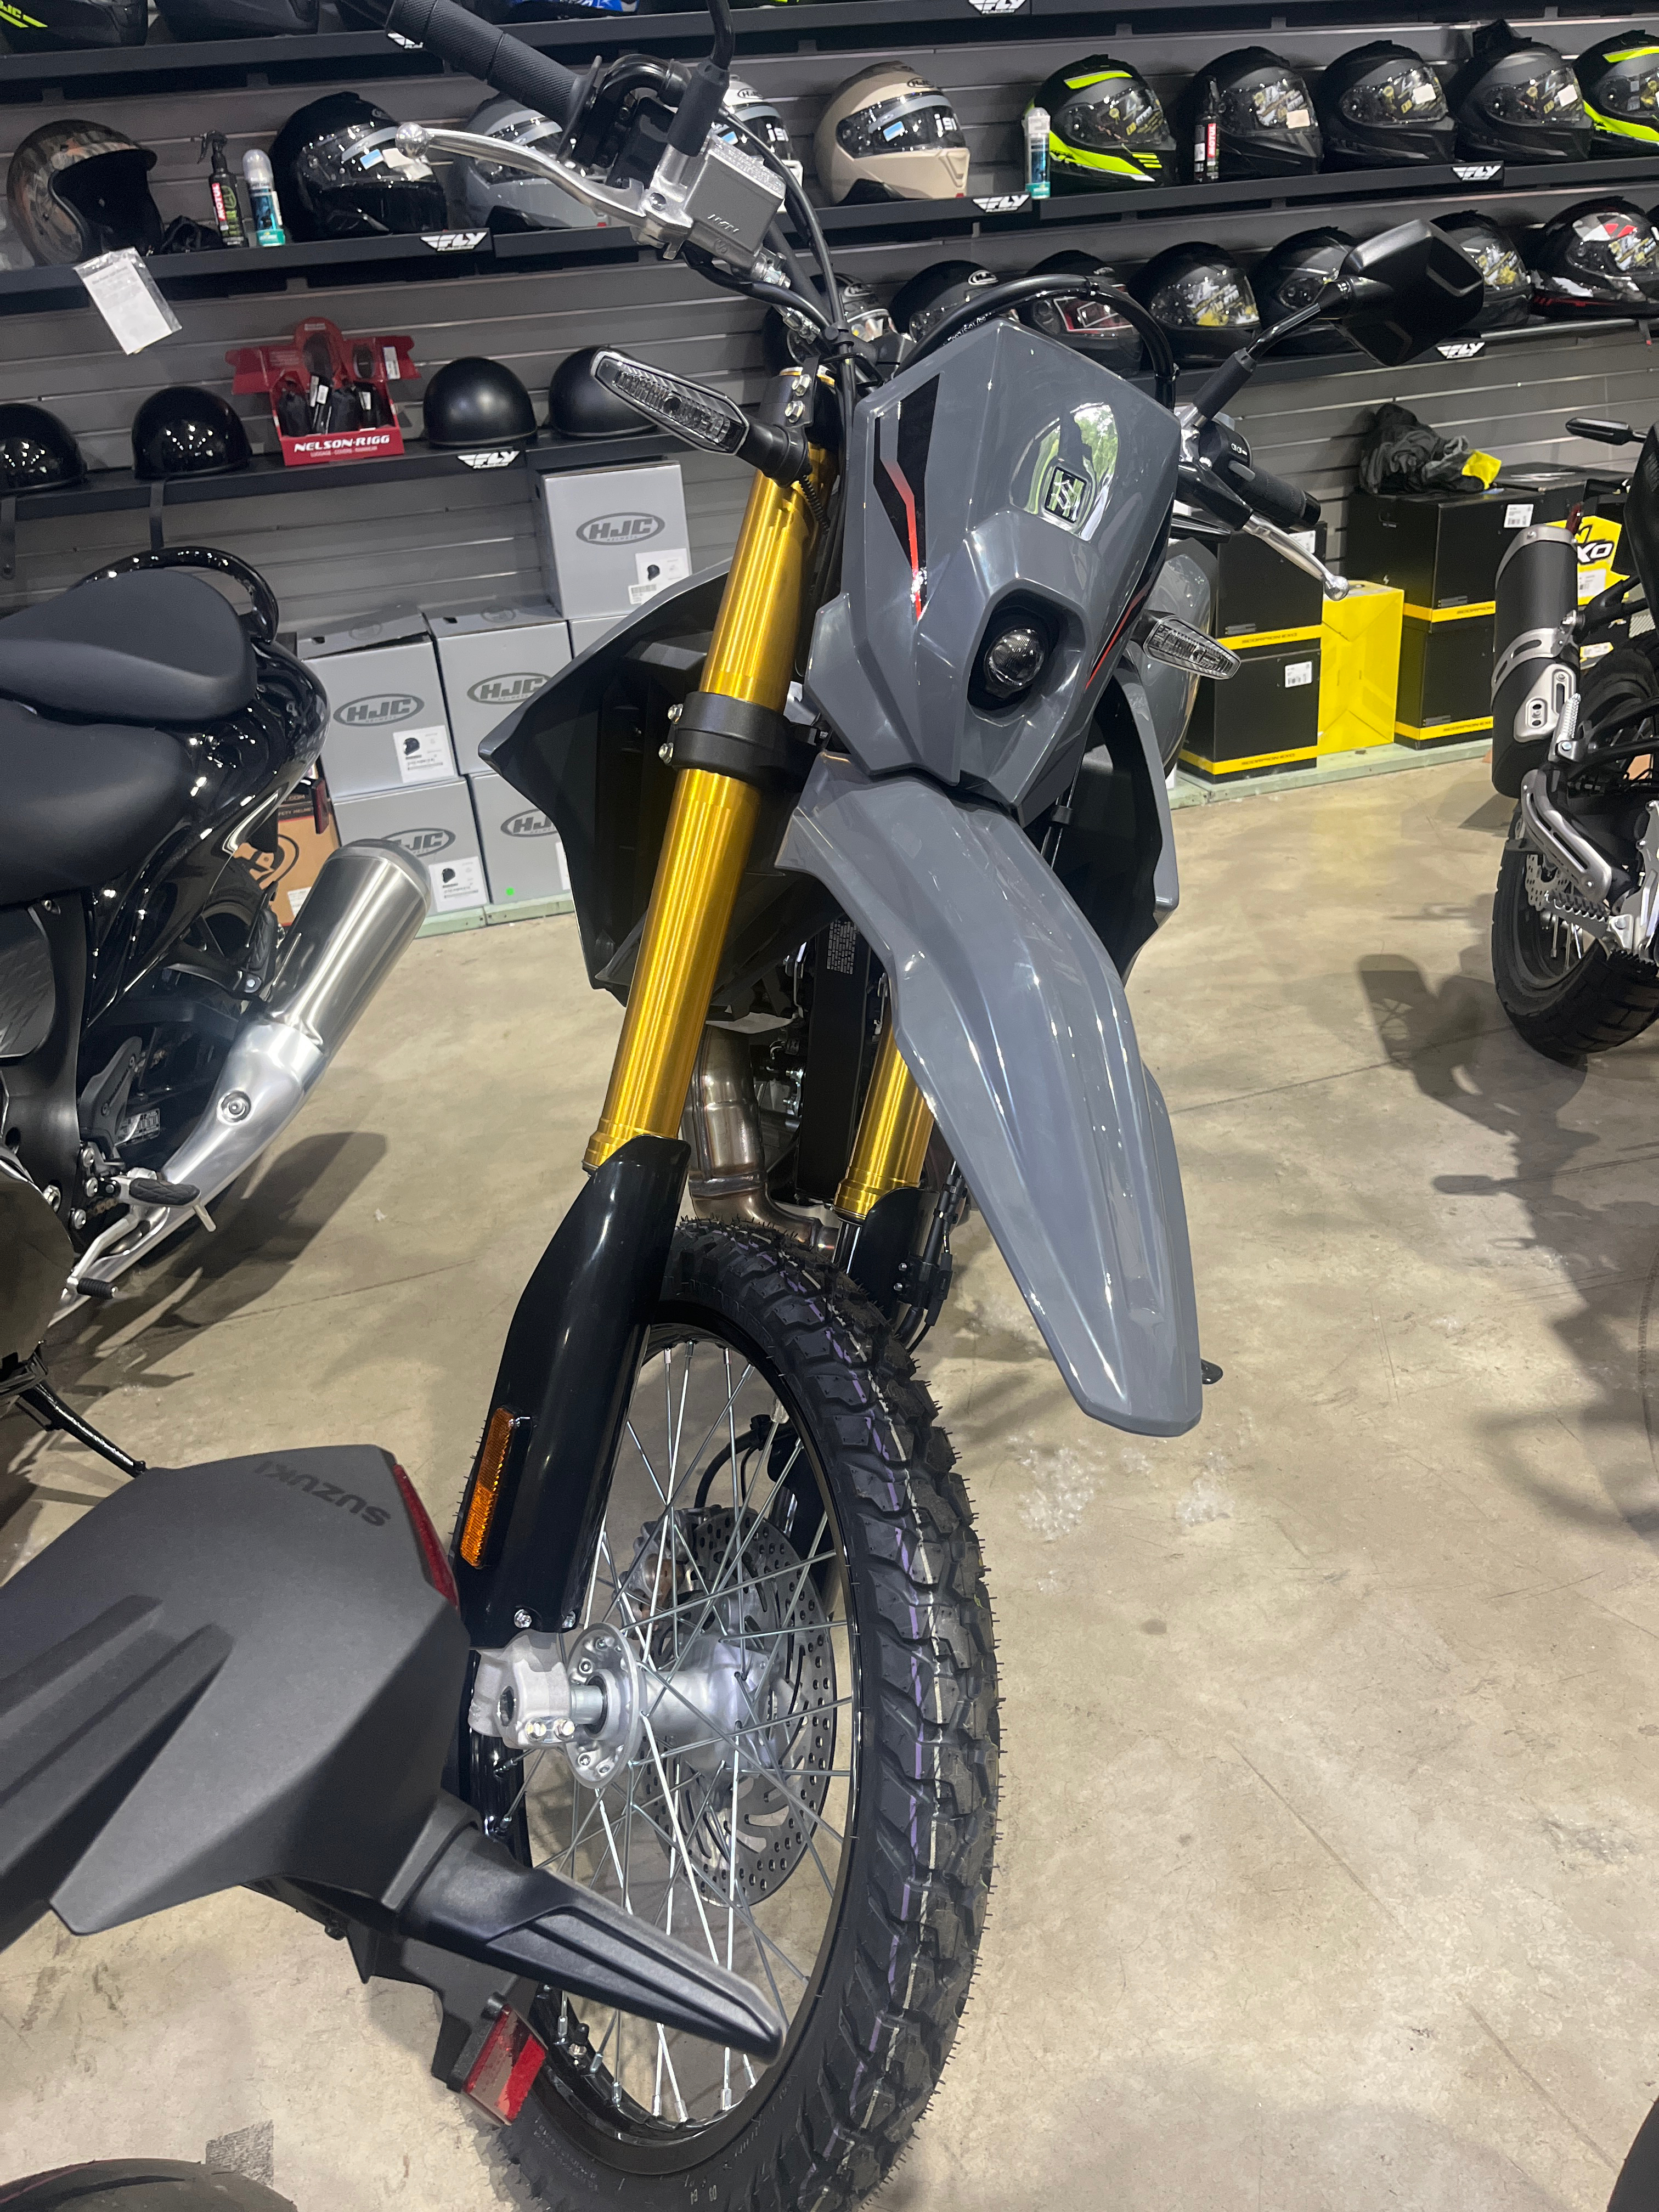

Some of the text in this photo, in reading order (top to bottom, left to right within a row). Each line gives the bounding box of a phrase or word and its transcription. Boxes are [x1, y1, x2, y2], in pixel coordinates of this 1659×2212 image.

[1464, 165, 1502, 177] FLY
[986, 195, 1030, 208] FLY
[438, 232, 487, 247] FLY
[1448, 342, 1485, 356] FLY
[473, 450, 520, 466] FLY
[589, 518, 653, 540] HJC
[1577, 542, 1613, 563] XO
[480, 678, 543, 699] HJC
[347, 698, 412, 722] HJC
[513, 816, 554, 833] HJ
[255, 1460, 391, 1527] SUZUKI
